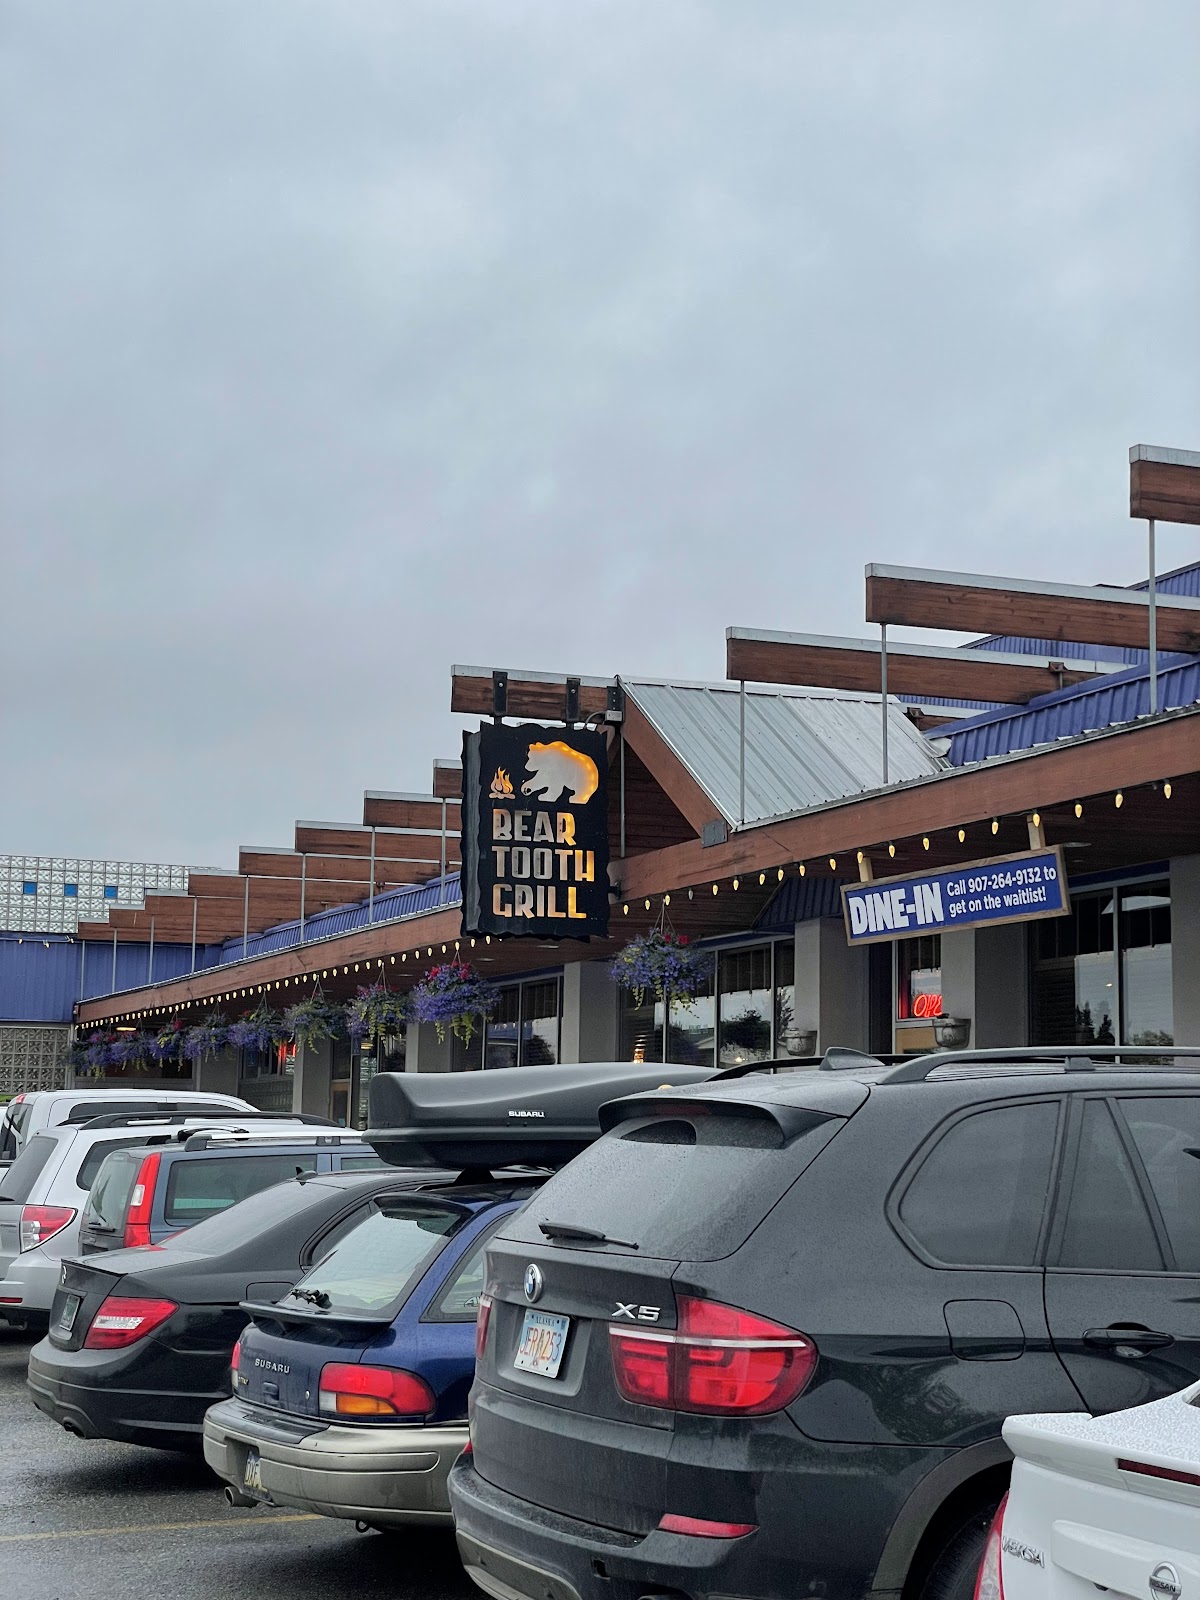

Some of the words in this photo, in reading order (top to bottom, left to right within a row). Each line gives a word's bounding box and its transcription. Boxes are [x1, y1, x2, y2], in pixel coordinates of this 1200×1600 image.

[492, 808, 577, 846] BEAR
[491, 846, 595, 882] TOOTH
[946, 879, 966, 897] Call
[968, 867, 1042, 893] 907-264-9132
[1043, 866, 1057, 881] to
[492, 883, 587, 919] GRILL
[849, 882, 944, 935] DINE-IN
[949, 899, 967, 918] get
[968, 899, 982, 912] on
[984, 894, 1001, 910] the
[1003, 886, 1047, 907] waitlist!
[914, 994, 942, 1018] OPE
[508, 1110, 545, 1118] SUBARU
[611, 1302, 661, 1322] X5
[254, 1358, 290, 1374] SUBARU
[1002, 1536, 1045, 1569] VERSA
